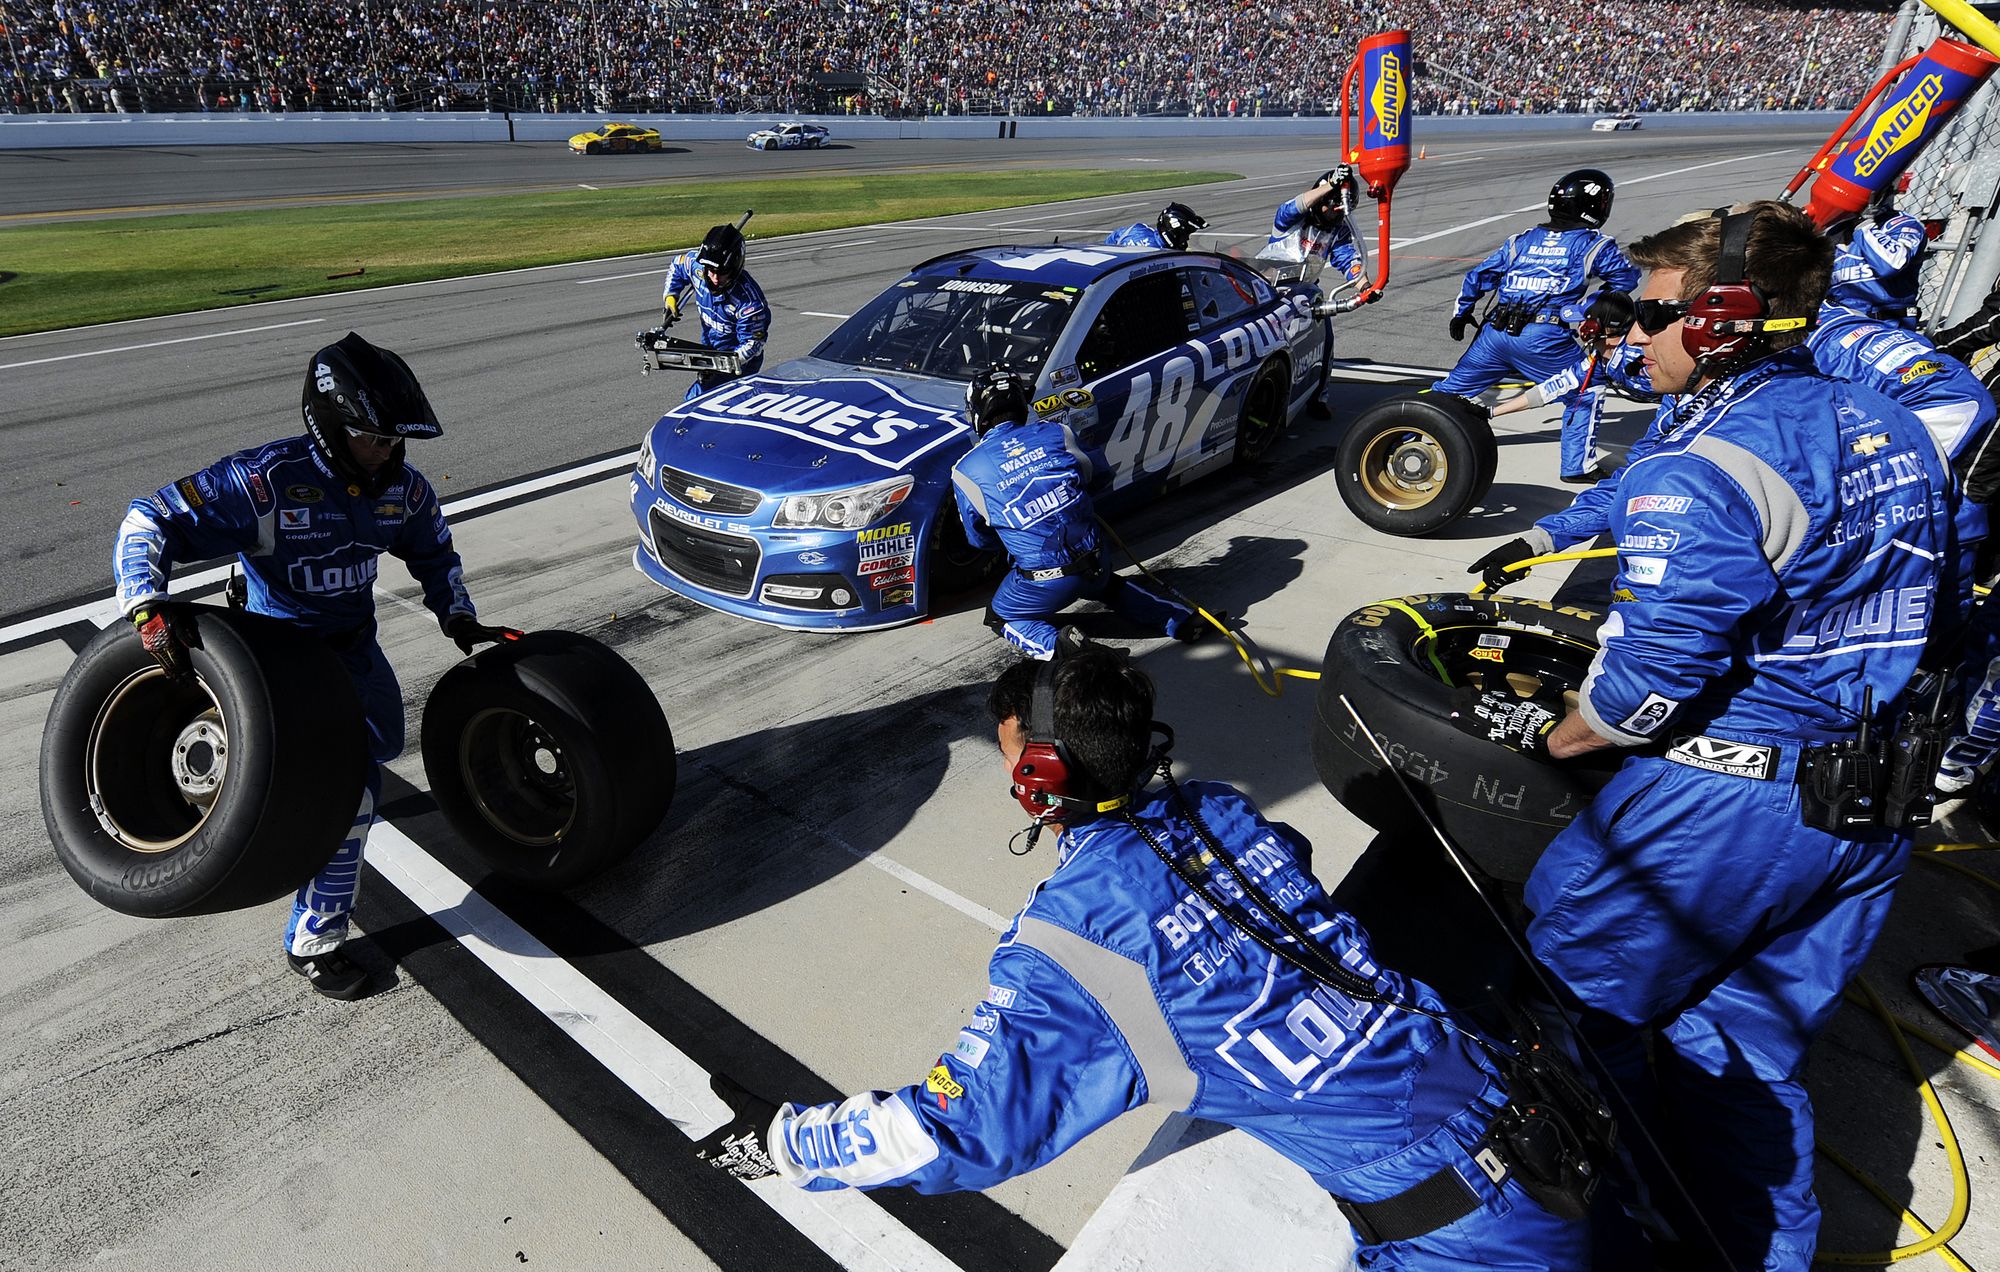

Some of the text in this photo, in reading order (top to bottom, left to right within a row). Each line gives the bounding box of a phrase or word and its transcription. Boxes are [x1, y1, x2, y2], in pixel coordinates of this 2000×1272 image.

[1383, 57, 1398, 135] SUNOCO
[1859, 79, 1938, 174] SUNOCO
[787, 134, 801, 146] 55
[1584, 183, 1601, 196] 48
[1528, 246, 1567, 256] HARDER
[937, 279, 1013, 295] JOHNSON
[1770, 321, 1792, 329] Sprint
[315, 363, 335, 393] 48
[700, 385, 919, 446] LOWE'S
[1105, 356, 1195, 491] 48
[407, 424, 437, 433] KOBALT
[1000, 447, 1047, 475] WAUGH
[1841, 451, 1928, 506] COLLIN
[1012, 480, 1077, 526] LOWE'S
[1632, 498, 1683, 513] NASCAR
[656, 498, 750, 533] CHEVROLET SS
[285, 531, 331, 541] GOODYEAR
[857, 522, 911, 543] MOOG
[861, 537, 914, 558] MAHLE
[873, 570, 911, 587] Edelbrock
[1668, 749, 1764, 778] MECHANIX WEAR
[1473, 774, 1526, 811] PN
